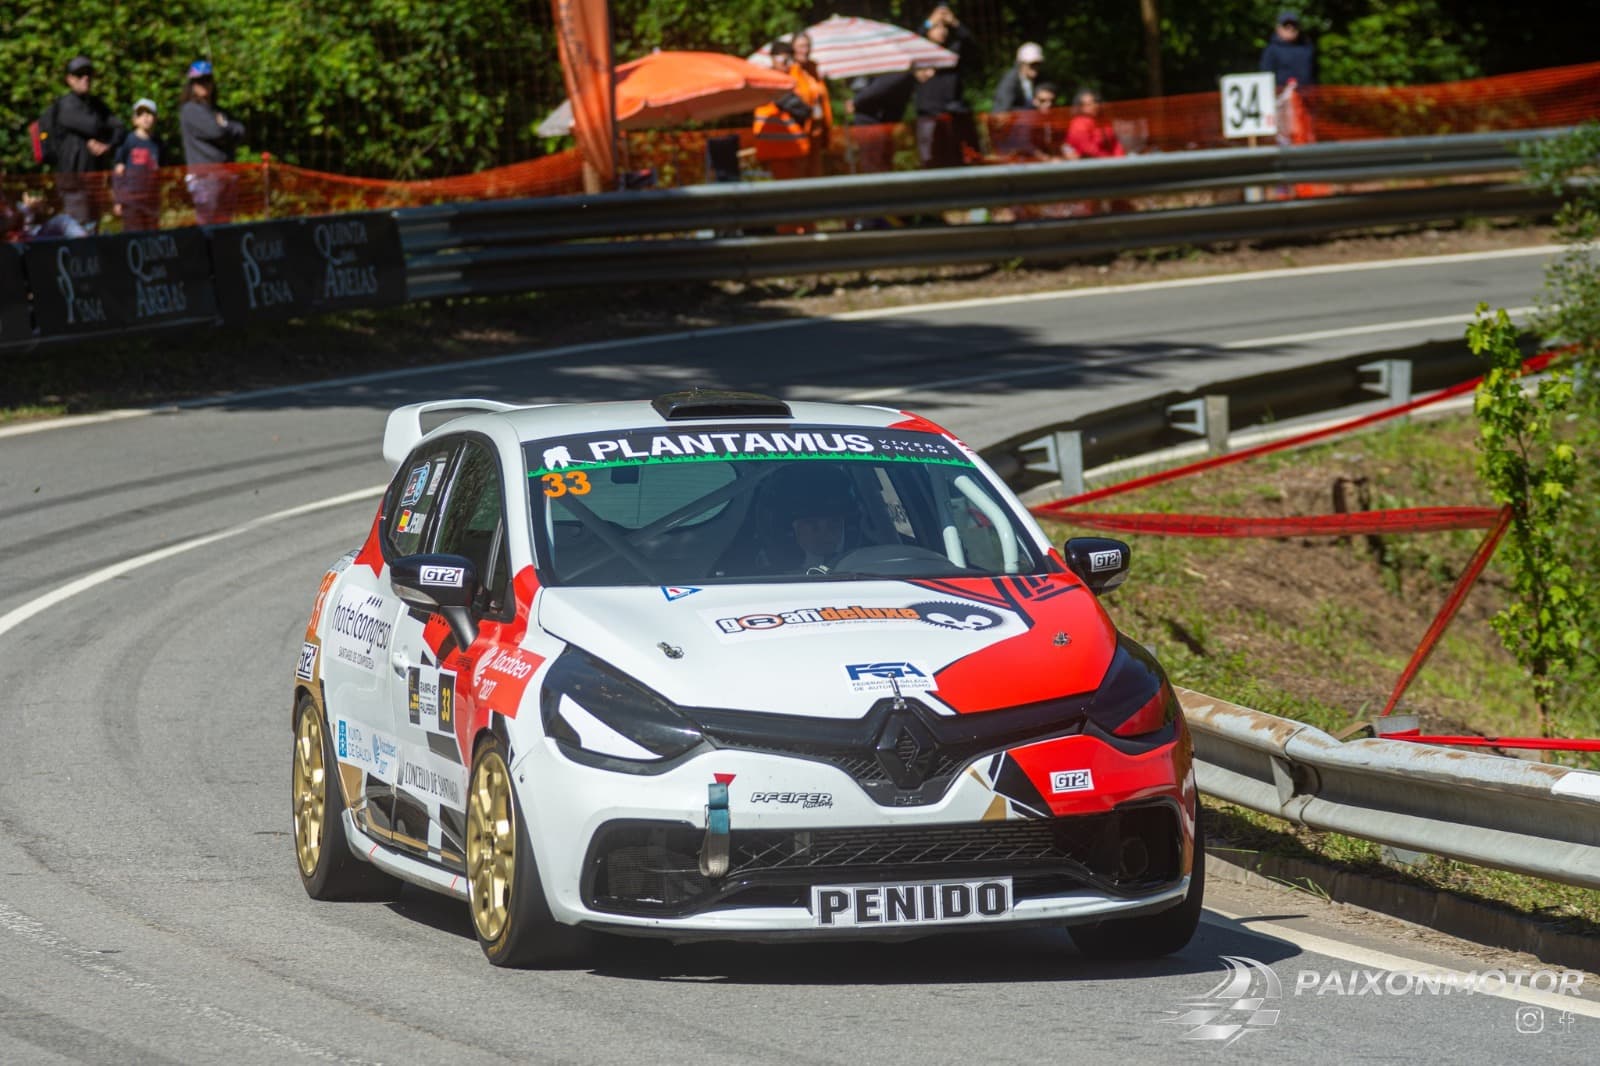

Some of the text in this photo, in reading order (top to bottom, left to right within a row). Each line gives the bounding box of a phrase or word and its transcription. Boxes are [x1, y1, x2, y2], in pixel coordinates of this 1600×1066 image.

[1228, 83, 1262, 129] 34
[588, 433, 874, 460] PLANTAMUS
[878, 439, 946, 450] VIVERO
[881, 444, 950, 455] ONLINE
[541, 471, 592, 498] 33
[1094, 551, 1120, 567] GT2i
[424, 567, 461, 583] GT2i
[845, 662, 927, 681] FGA
[442, 687, 451, 722] 33
[404, 761, 430, 793] CONCELLO
[430, 770, 438, 796] DE
[1054, 771, 1090, 787] GT2i
[751, 792, 833, 804] PFEIFER
[818, 881, 1008, 926] PENIDO
